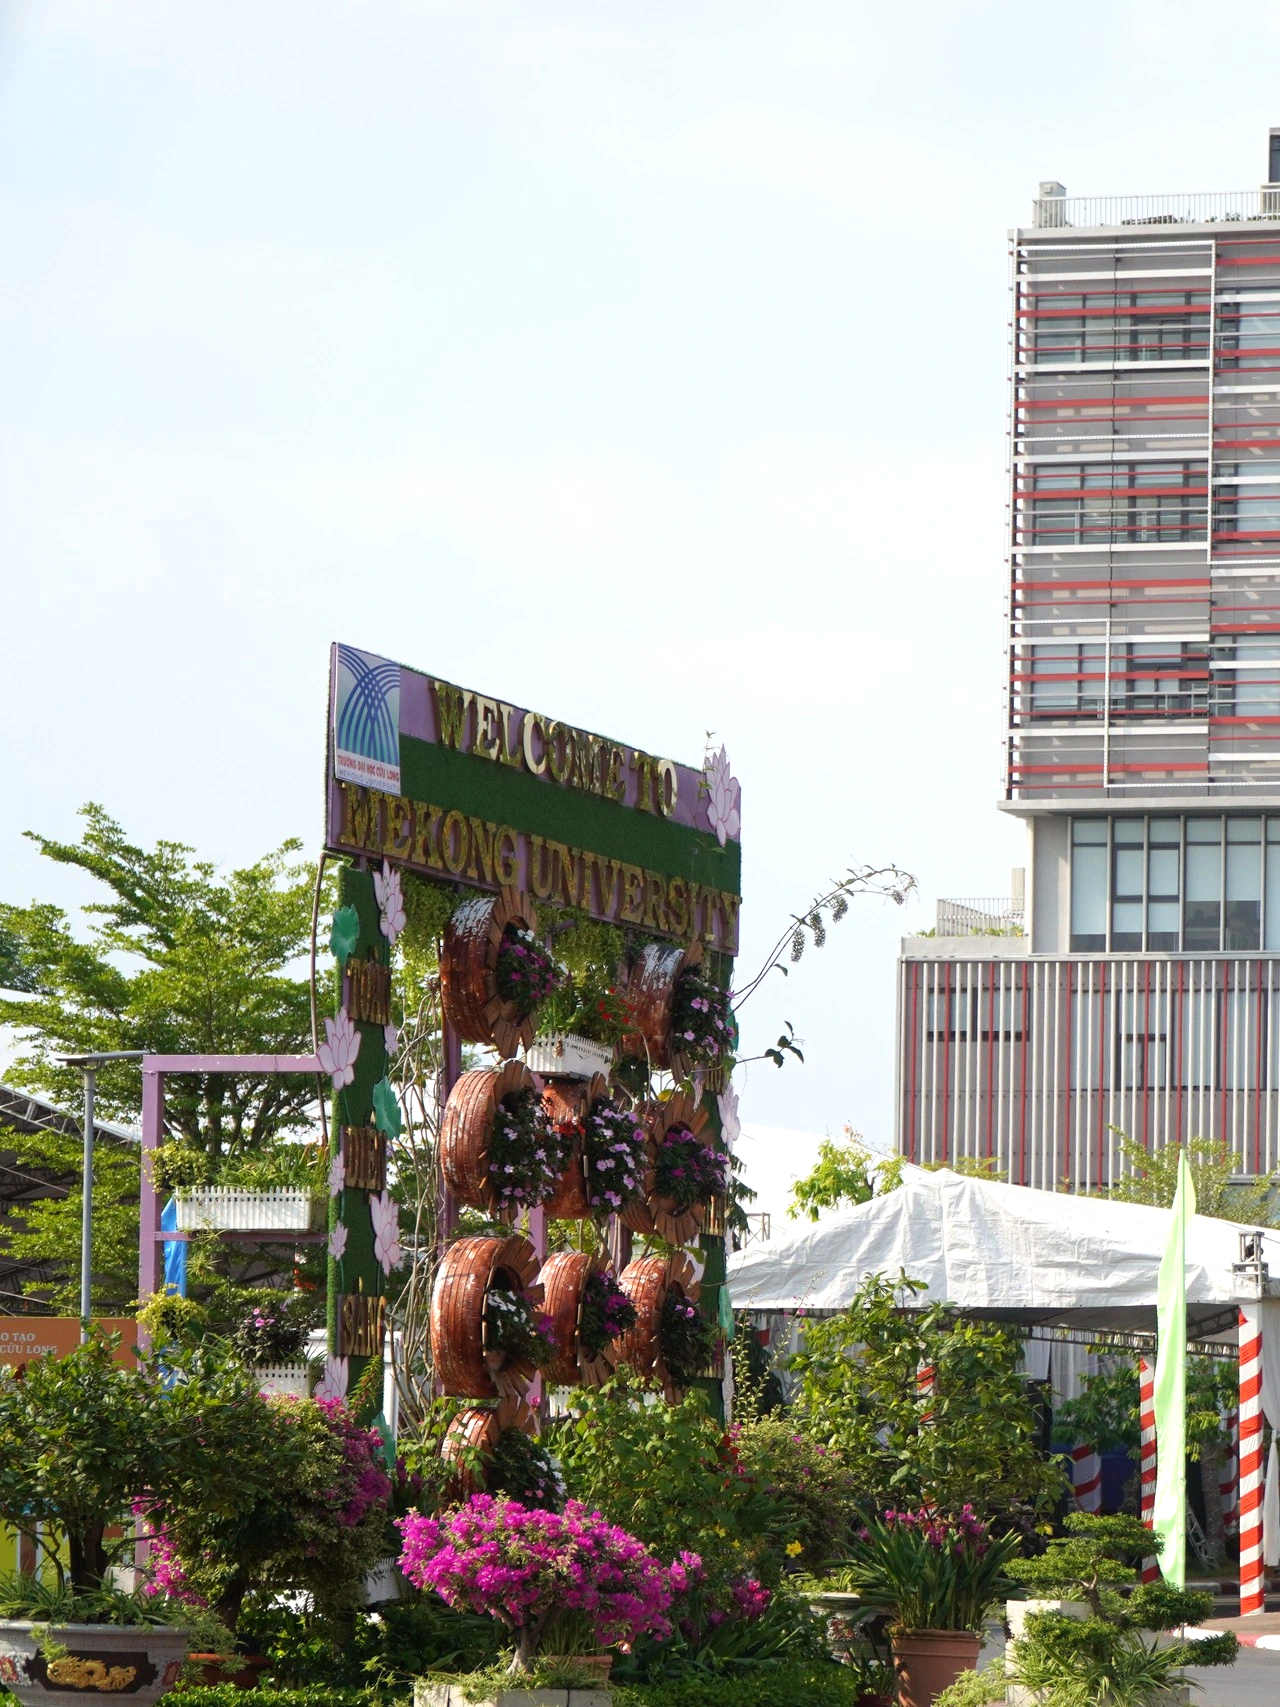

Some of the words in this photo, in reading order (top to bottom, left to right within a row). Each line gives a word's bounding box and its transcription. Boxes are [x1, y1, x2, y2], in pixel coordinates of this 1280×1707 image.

[428, 680, 626, 800] WELCOME
[630, 751, 678, 817] TO
[337, 783, 519, 886] MEKONG
[525, 834, 741, 949] UNIVERSITY
[26, 1345, 57, 1355] LONG
